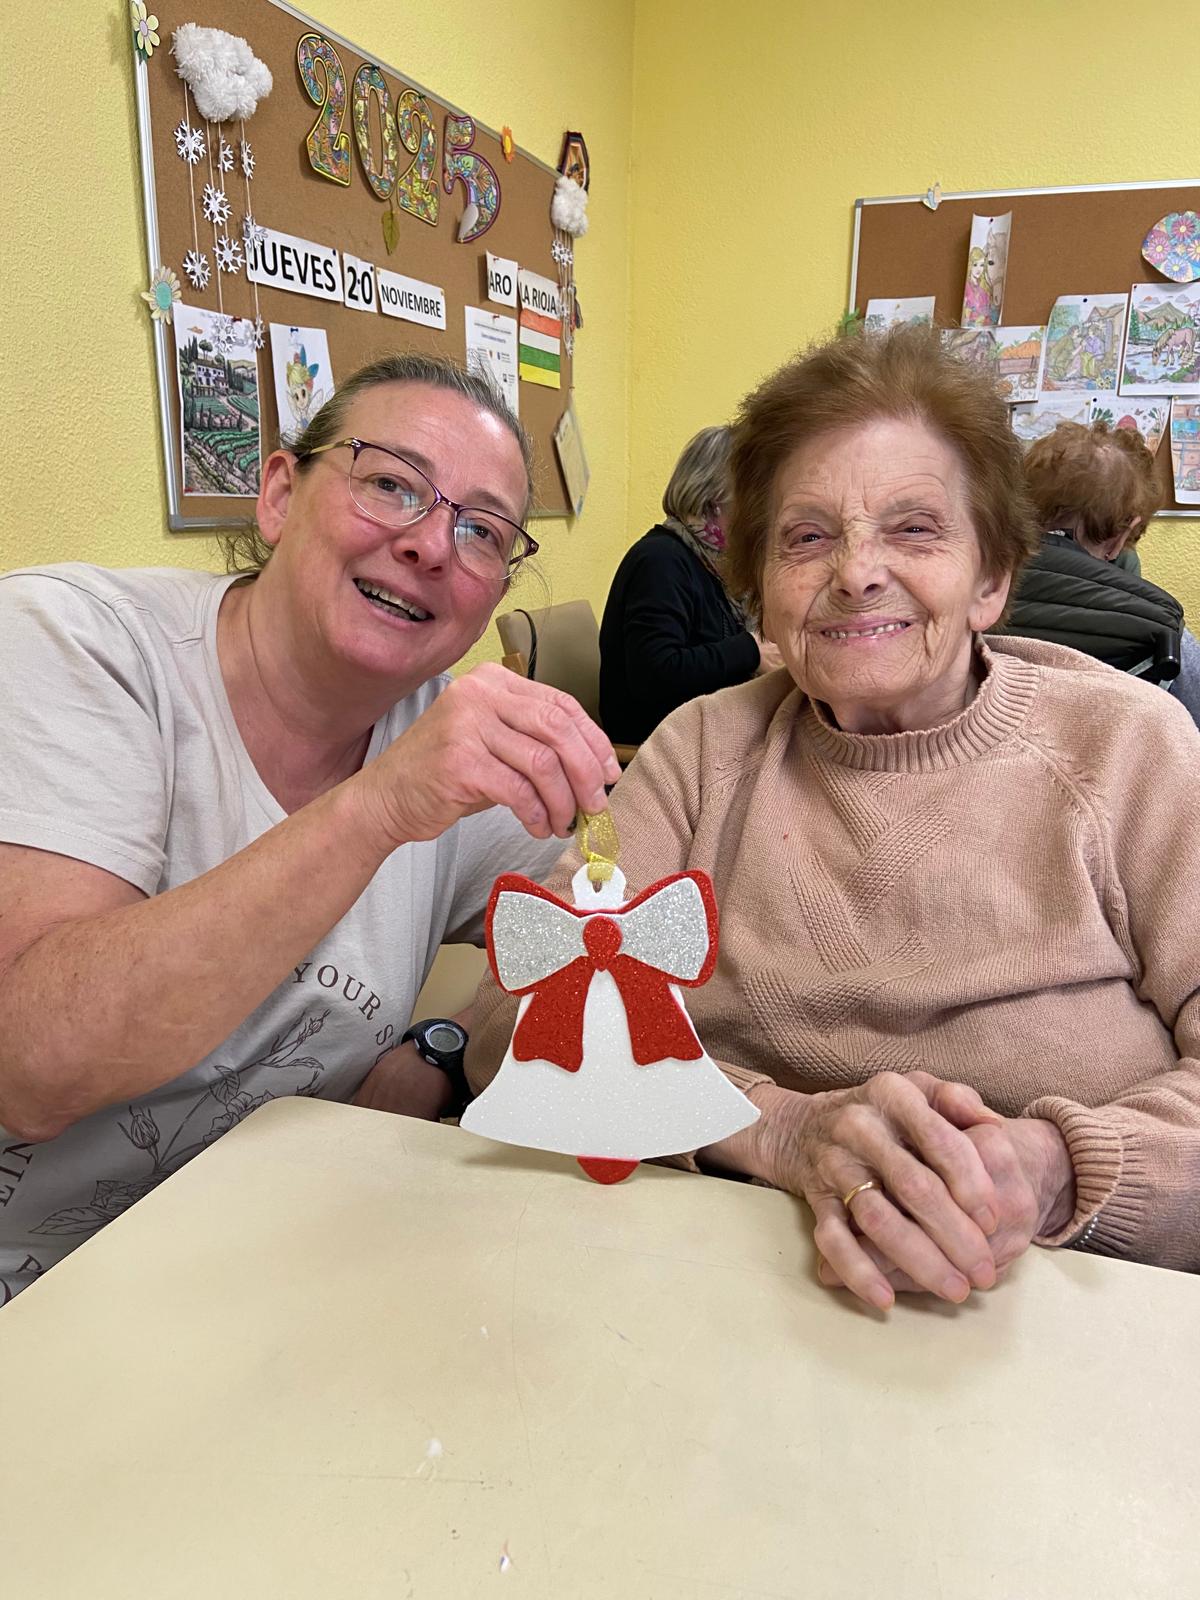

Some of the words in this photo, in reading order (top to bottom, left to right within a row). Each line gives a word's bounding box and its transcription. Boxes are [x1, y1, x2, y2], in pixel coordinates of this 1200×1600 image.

[297, 32, 500, 243] 2025
[250, 239, 336, 292] JUEVES
[347, 266, 373, 305] 20
[381, 284, 442, 319] NOVIEMBRE
[519, 282, 531, 305] LA
[532, 287, 558, 315] RIOJA
[292, 962, 381, 1021] YOUR
